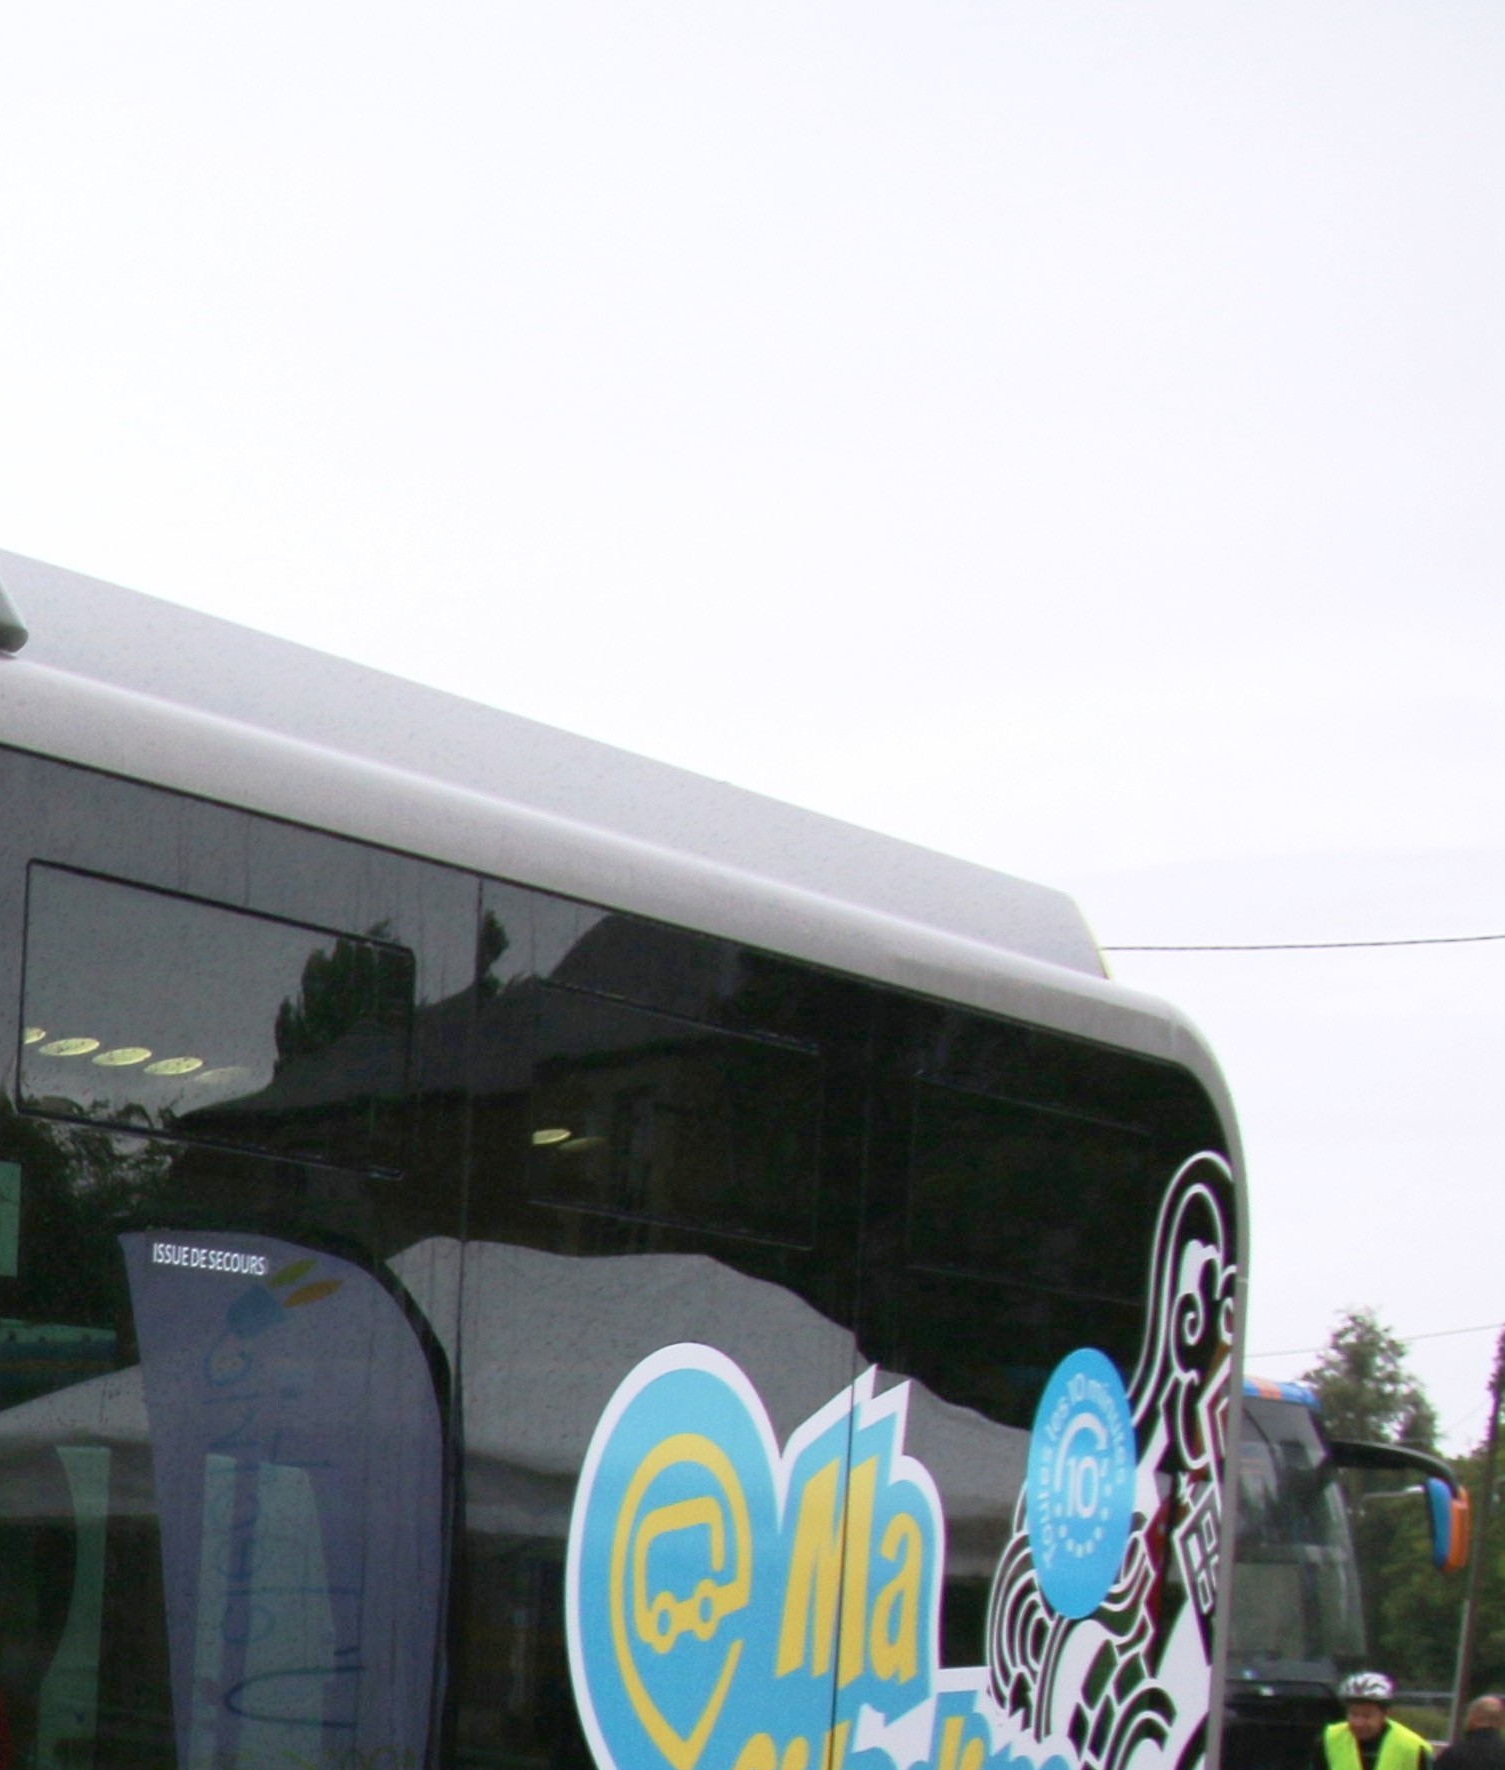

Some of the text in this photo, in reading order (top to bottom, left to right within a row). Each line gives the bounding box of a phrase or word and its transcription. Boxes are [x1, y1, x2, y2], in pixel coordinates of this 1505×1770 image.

[153, 1243, 266, 1276] ISSUE DE SECOURS
[773, 1455, 924, 1690] Ma
